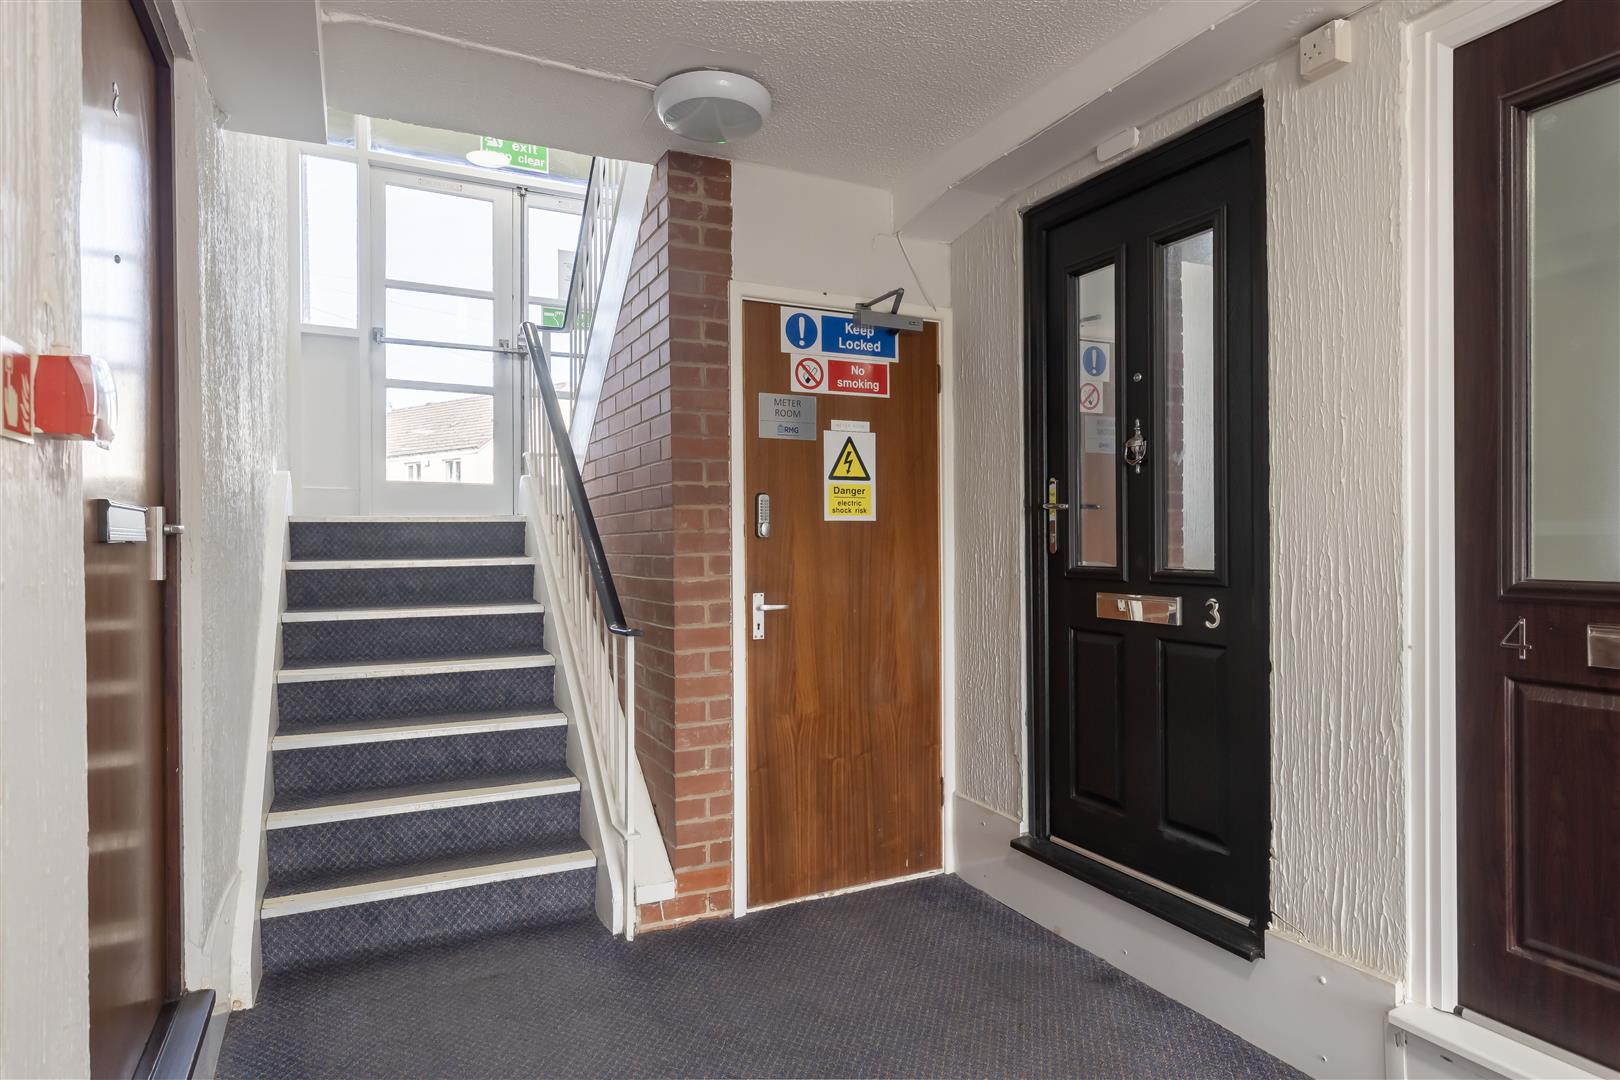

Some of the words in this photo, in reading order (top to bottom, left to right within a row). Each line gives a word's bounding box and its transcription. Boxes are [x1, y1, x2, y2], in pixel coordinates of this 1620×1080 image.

[511, 142, 538, 155] exit
[518, 154, 545, 167] clear
[845, 321, 875, 339] Keep
[838, 337, 881, 352] Locked
[851, 365, 865, 376] No
[837, 379, 880, 391] smoking
[774, 398, 802, 407] METER
[774, 409, 801, 418] ROOM
[833, 486, 866, 496] Danger
[837, 499, 862, 507] electric
[1204, 598, 1221, 629] 3
[1500, 617, 1532, 660] 4
